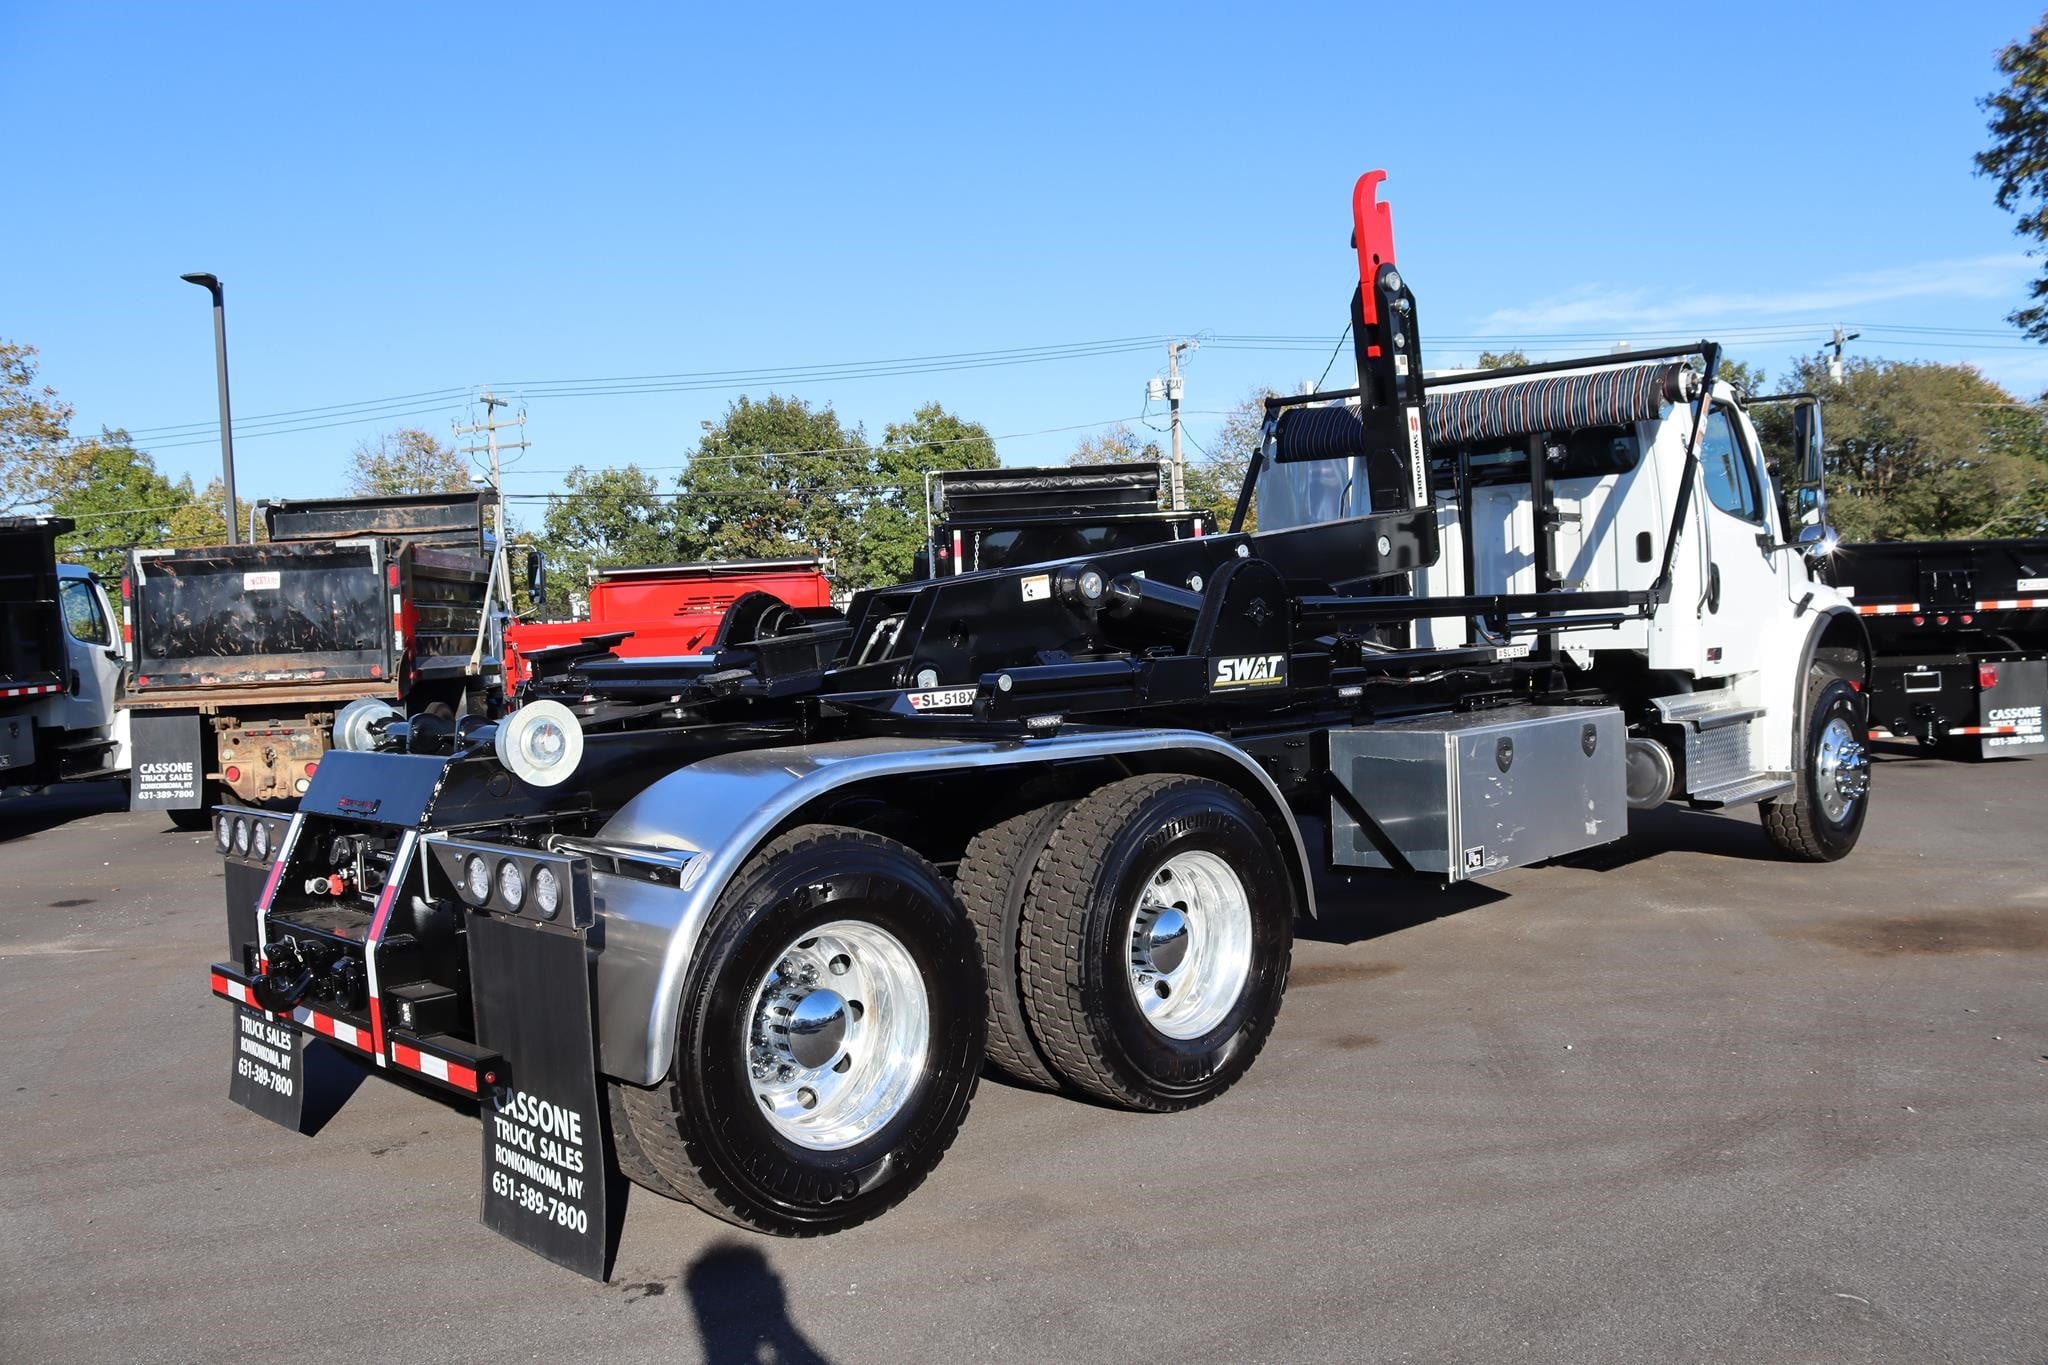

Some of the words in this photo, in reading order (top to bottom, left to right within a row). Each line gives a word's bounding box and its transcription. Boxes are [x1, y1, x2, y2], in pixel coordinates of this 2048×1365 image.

[1413, 433, 1423, 498] SWAPLOADER
[1215, 655, 1283, 682] SWAT
[1989, 707, 2041, 719] CASSONE
[139, 762, 193, 774] CASSONE
[140, 774, 167, 782] TRUCK
[169, 773, 193, 781] SALES
[138, 790, 195, 799] 631-389-7800
[240, 1015, 265, 1040] TRUCK
[266, 1026, 291, 1050] SALES
[240, 1036, 281, 1070] RONKONKOMA,
[281, 1053, 291, 1071] NY
[238, 1057, 293, 1096] 631-389-7800
[494, 1116, 536, 1154] TRUCK
[539, 1137, 584, 1173] SALES
[495, 1144, 566, 1196] RONKONKOMA,
[567, 1176, 583, 1199] NY
[492, 1171, 588, 1234] 631-389-7800
